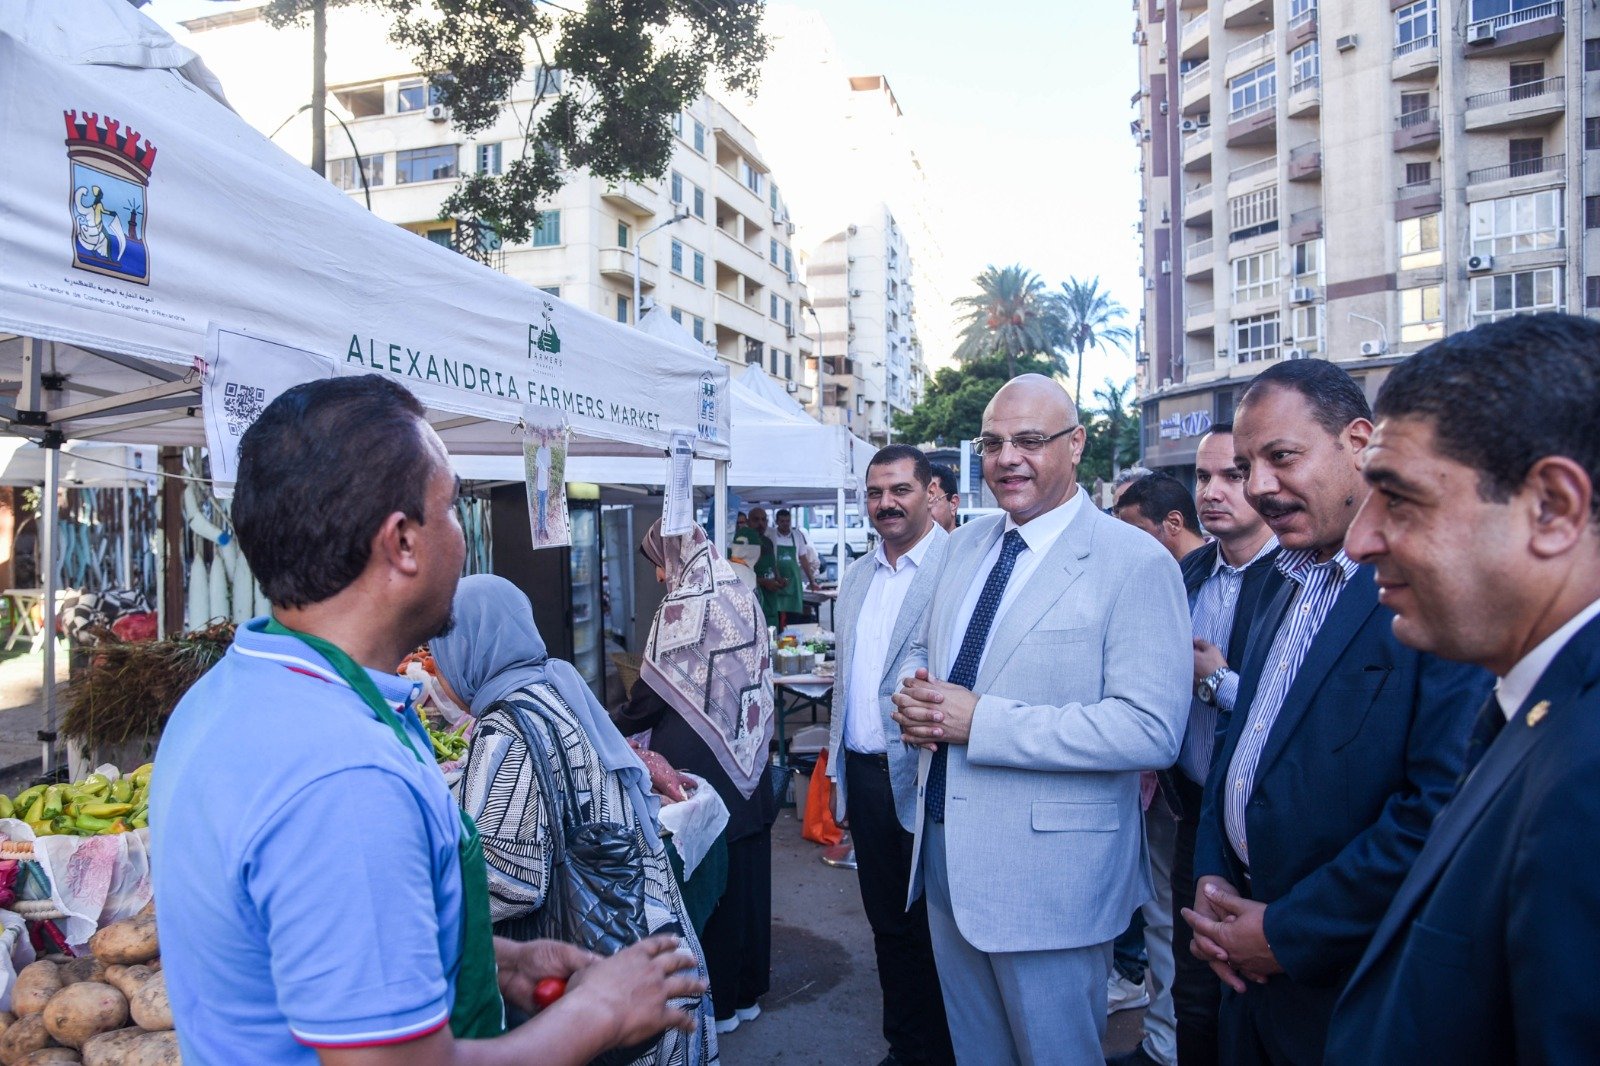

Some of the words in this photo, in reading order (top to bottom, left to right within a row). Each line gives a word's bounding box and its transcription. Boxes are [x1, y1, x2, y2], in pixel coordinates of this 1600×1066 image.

[347, 334, 520, 400] ALEXANDRIA
[528, 380, 605, 419] FARMERS
[610, 402, 660, 431] MARKET
